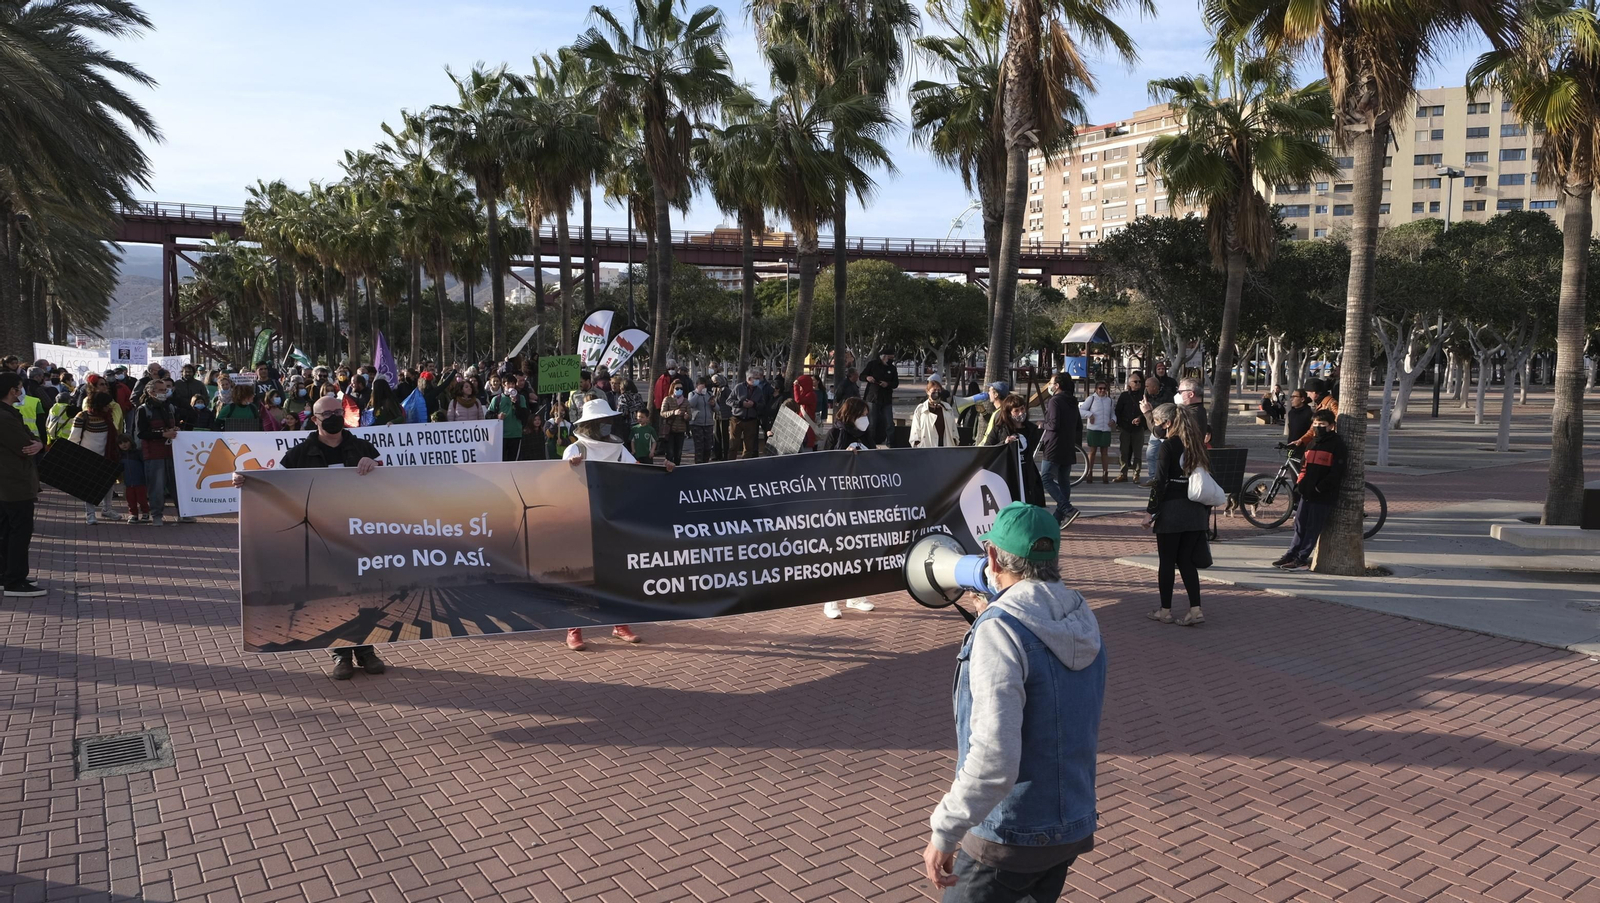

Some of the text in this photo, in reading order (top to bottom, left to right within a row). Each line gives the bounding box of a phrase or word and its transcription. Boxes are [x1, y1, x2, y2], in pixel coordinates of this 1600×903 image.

[582, 335, 606, 345] USTEA
[539, 381, 579, 393] LUCAINENA
[548, 370, 570, 378] VALLE
[275, 425, 490, 451] PLAT PARA LA PROTECCIÓN
[386, 448, 477, 466] A VÍA VERDE DE
[678, 472, 902, 504] ALIANZA ENERGÍA Y TERRITORIO
[348, 512, 493, 538] Renovables SÍ,
[673, 504, 927, 538] POR UNA TRANSICIÓN ENERGÉTICA
[976, 522, 994, 535] ALI
[627, 546, 734, 570] REALMENTE
[738, 537, 833, 561] ECOLÓGICA,
[835, 530, 910, 552] SOSTENIBLE
[910, 528, 919, 543] Y
[357, 553, 406, 576] pero
[412, 549, 447, 567] NO
[642, 553, 907, 596] CON TODAS LAS PERSONAS Y TERR
